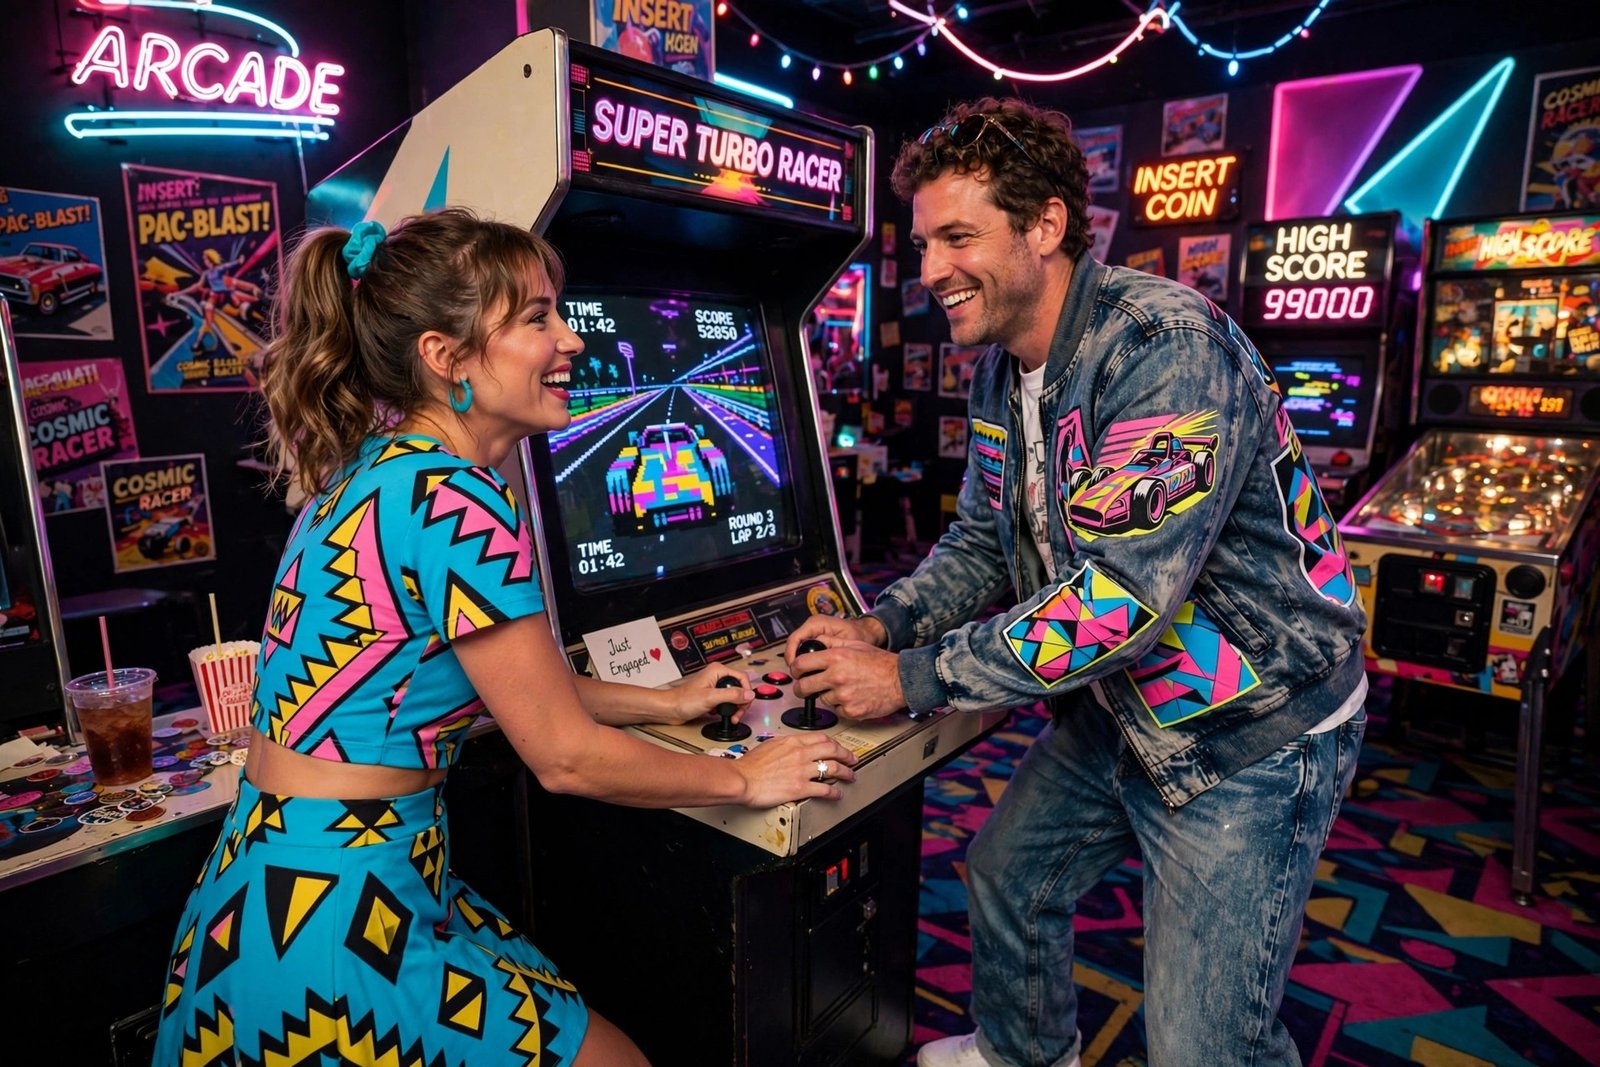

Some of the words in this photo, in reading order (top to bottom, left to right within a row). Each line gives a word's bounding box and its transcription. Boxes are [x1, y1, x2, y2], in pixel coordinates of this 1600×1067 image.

[613, 0, 694, 32] INSERT
[72, 25, 345, 115] ARCADE
[592, 98, 689, 160] SUPER
[696, 122, 774, 178] TURBO
[777, 146, 843, 193] RACER
[1134, 155, 1237, 195] INSERT
[1145, 188, 1218, 222] COIN
[138, 201, 270, 245] PAC-BLAST!
[1276, 222, 1353, 254] HIGH
[1264, 250, 1369, 282] SCORE
[565, 301, 604, 317] TIME
[695, 309, 735, 326] SCORE
[1263, 286, 1375, 320] 99000
[567, 317, 616, 333] 01:42
[697, 324, 739, 341] 52850
[32, 426, 115, 470] RACER
[113, 463, 196, 498] COSMIC
[139, 485, 192, 511] RACER
[728, 512, 764, 530] ROUND
[766, 509, 774, 523] 3
[730, 529, 752, 545] LAP
[755, 523, 776, 539] 2/3
[577, 539, 613, 558] TIME
[578, 552, 625, 574] 01:42
[608, 637, 631, 656] Just
[609, 650, 650, 678] Engaged
